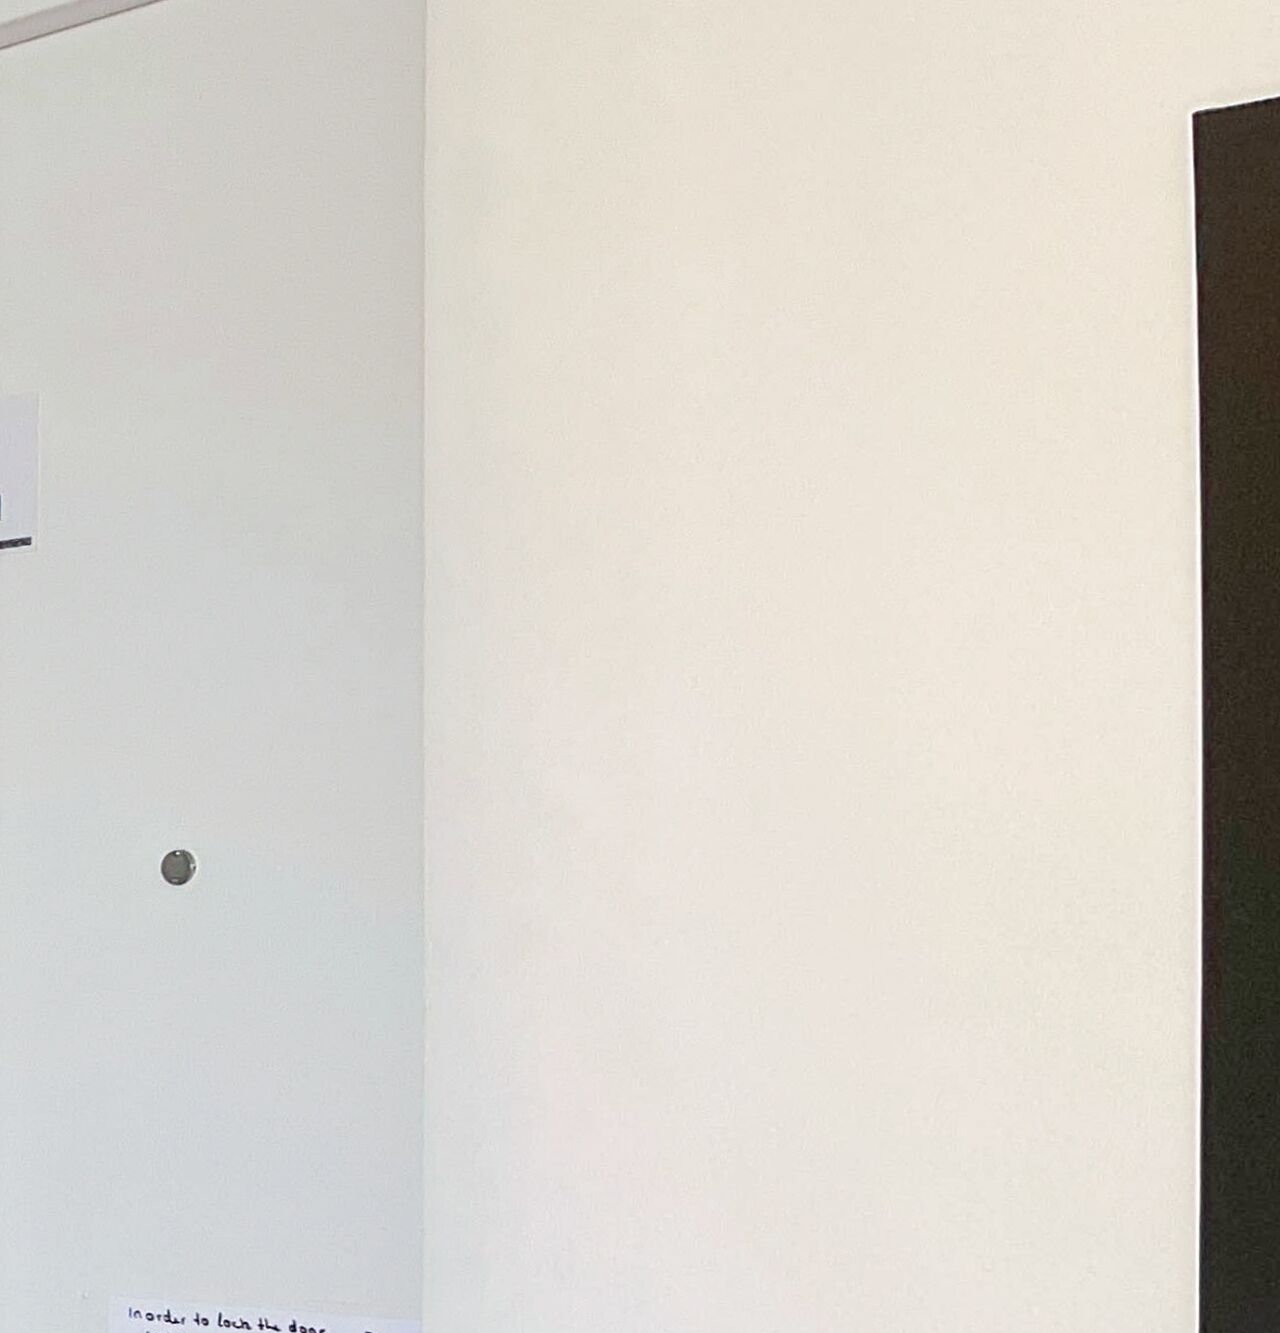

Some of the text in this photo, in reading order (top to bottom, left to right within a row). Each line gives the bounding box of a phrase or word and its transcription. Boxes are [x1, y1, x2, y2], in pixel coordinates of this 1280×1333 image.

[145, 1309, 186, 1325] order
[194, 1312, 210, 1326] to
[217, 1312, 252, 1330] lock
[258, 1318, 281, 1332] the
